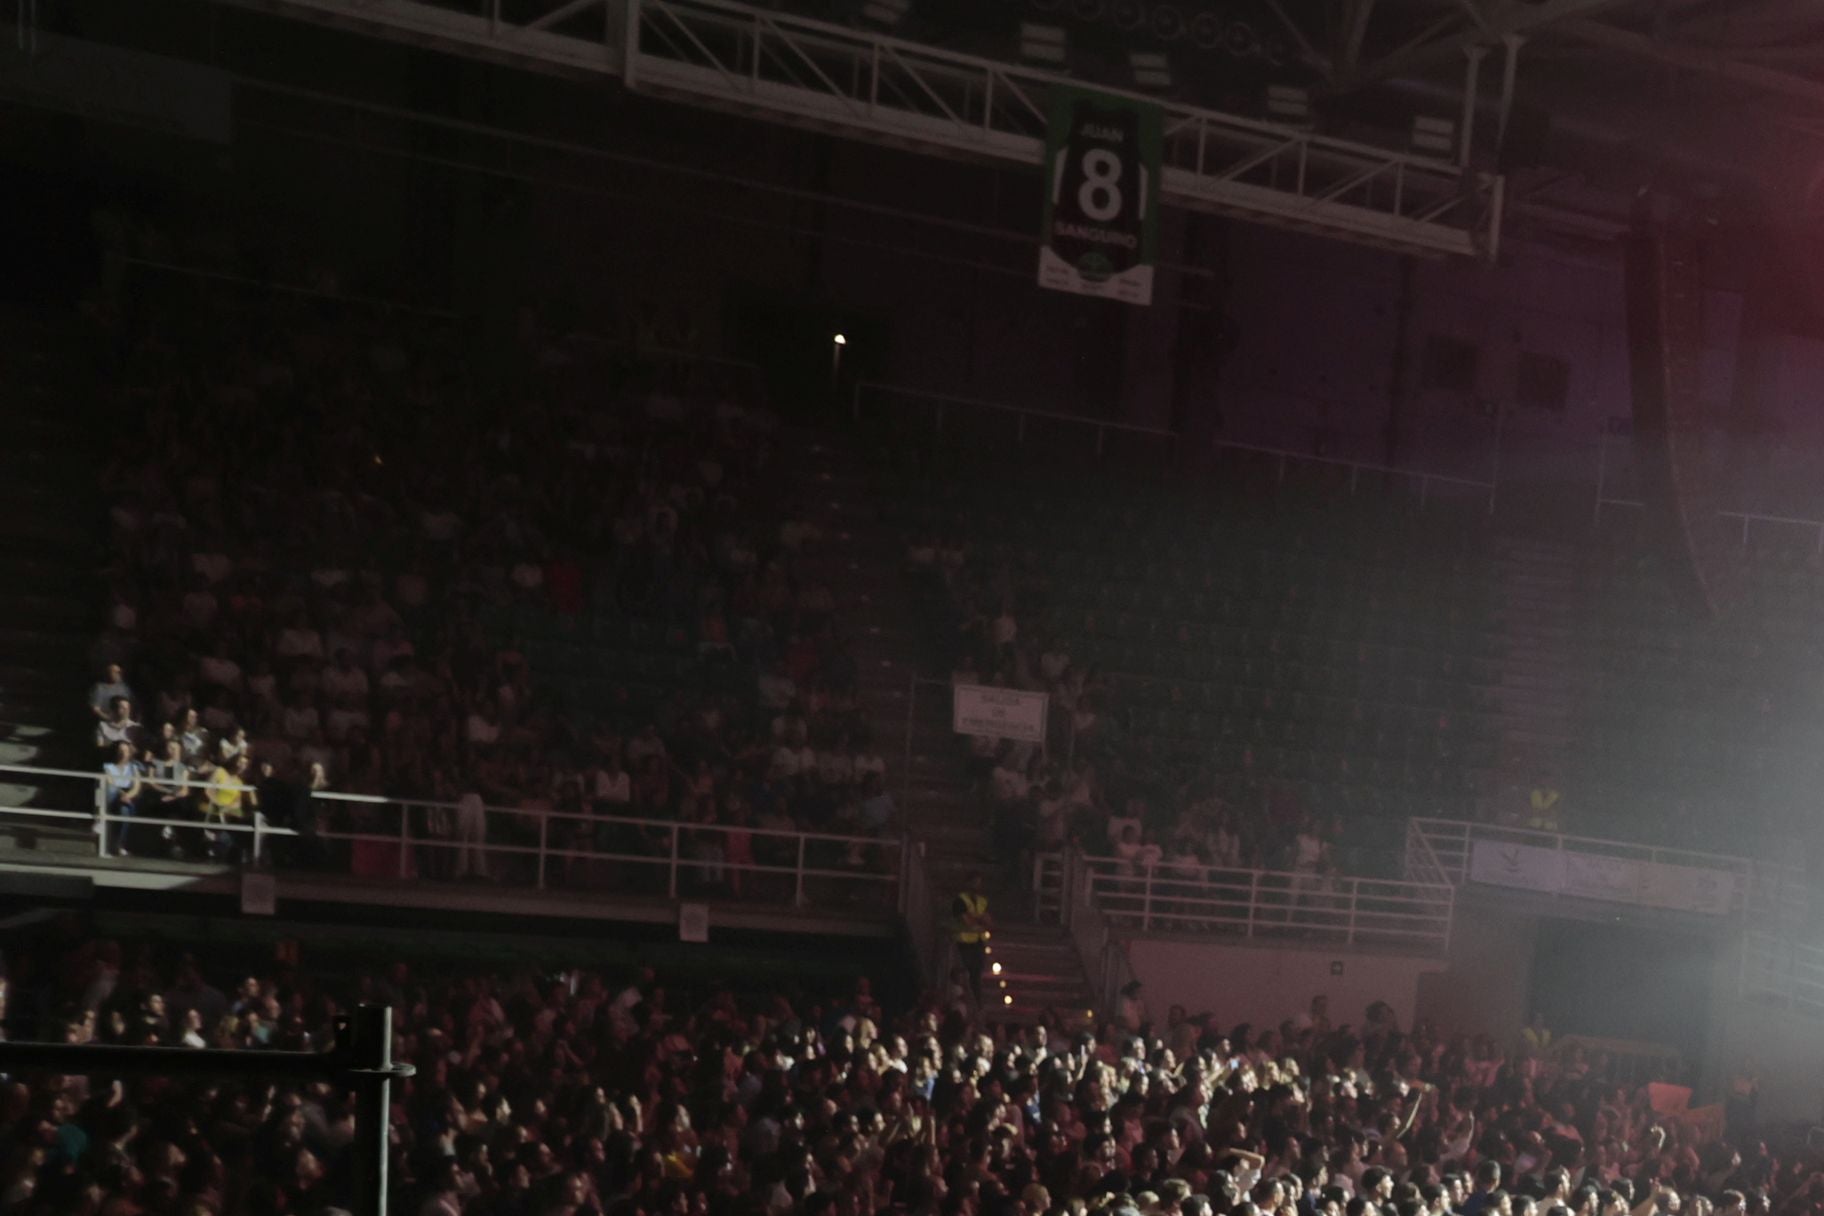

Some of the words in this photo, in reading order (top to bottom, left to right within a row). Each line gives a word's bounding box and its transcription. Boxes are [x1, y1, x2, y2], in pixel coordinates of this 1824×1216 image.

[1080, 122, 1123, 142] JUAN
[1078, 148, 1123, 221] 8
[1054, 220, 1138, 248] SANGUINO
